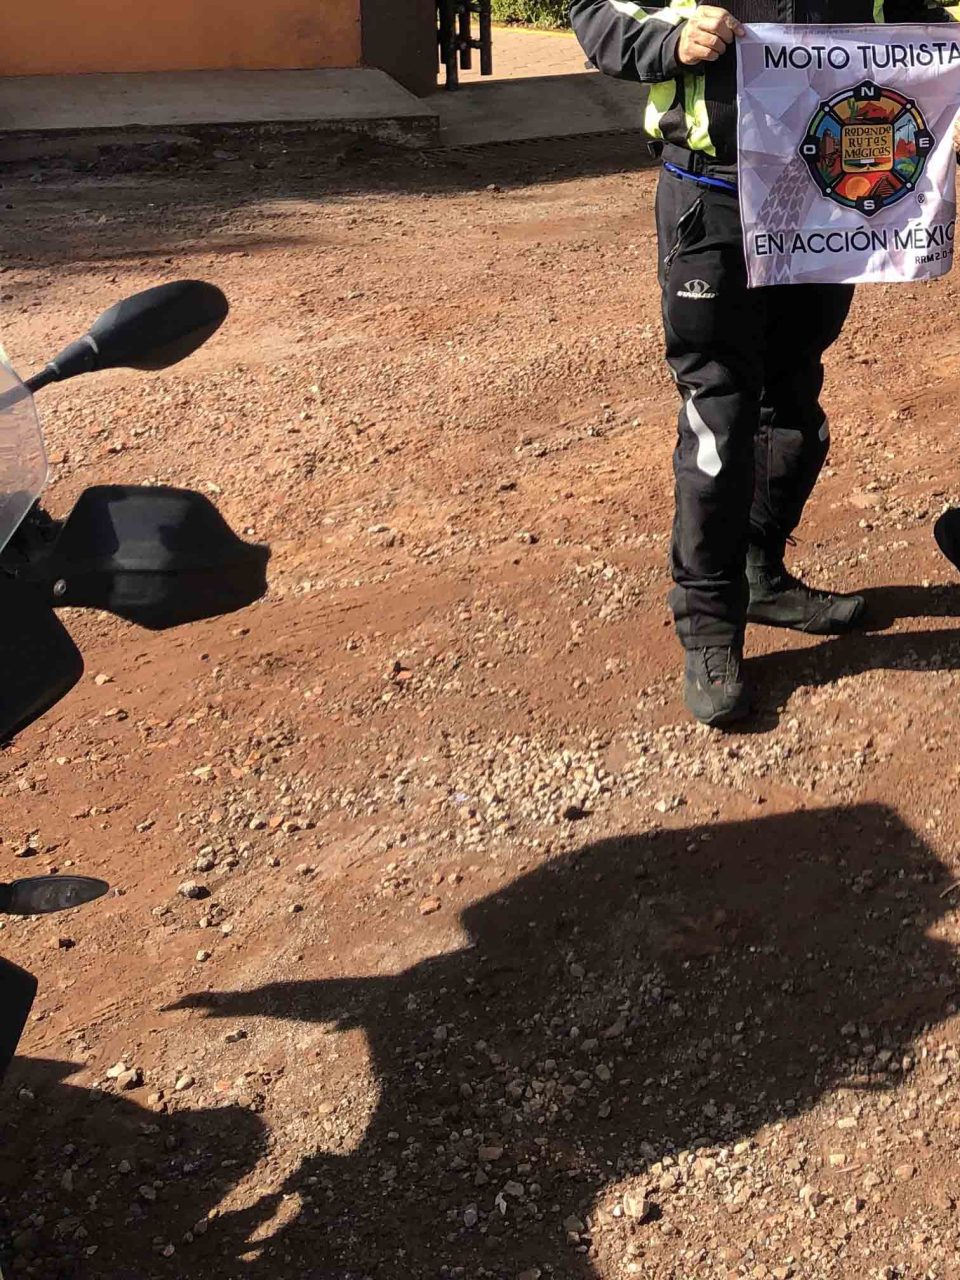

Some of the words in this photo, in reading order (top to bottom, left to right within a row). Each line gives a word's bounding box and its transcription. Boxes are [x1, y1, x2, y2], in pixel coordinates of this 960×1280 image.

[764, 44, 850, 70] MOTO
[860, 86, 875, 97] N
[919, 137, 930, 148] E
[863, 199, 875, 210] S
[754, 231, 784, 256] EN
[791, 226, 887, 255] ACCIÓN
[915, 254, 934, 265] RRM
